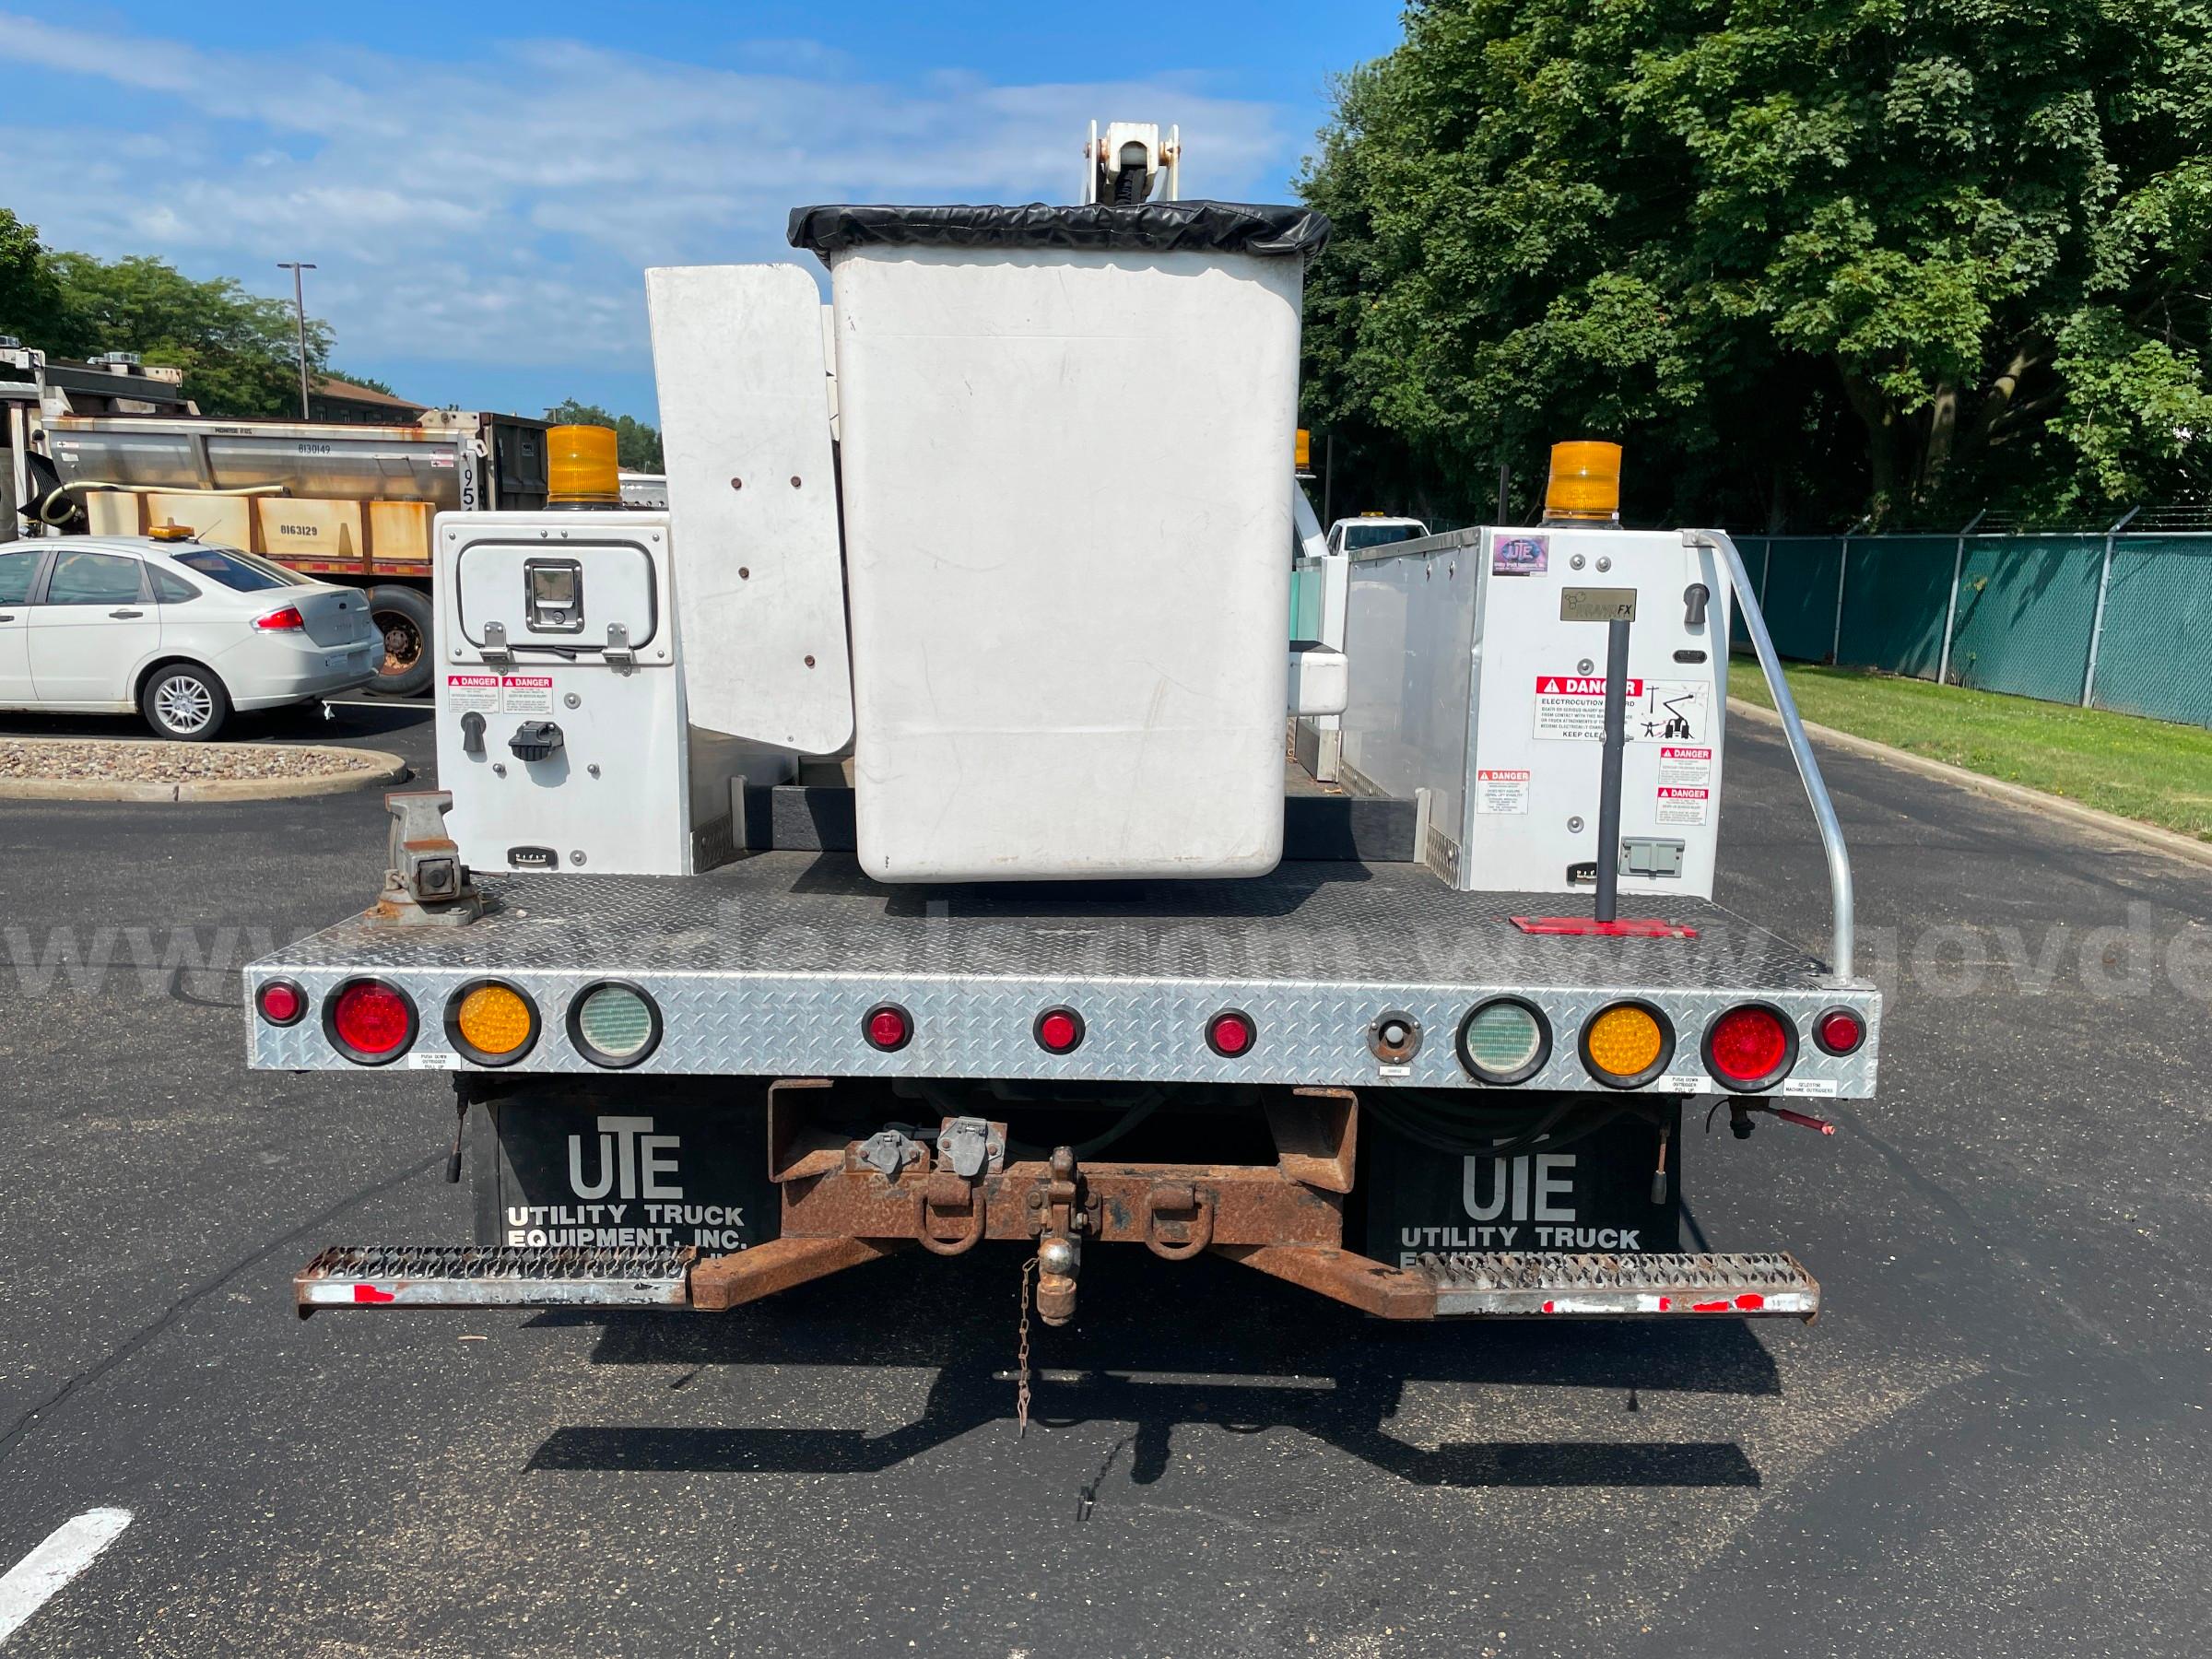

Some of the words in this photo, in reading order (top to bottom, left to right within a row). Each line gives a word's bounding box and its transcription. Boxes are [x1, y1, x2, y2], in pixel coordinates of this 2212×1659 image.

[299, 443, 331, 454] 8130149
[463, 469, 475, 512] 95
[280, 524, 318, 536] 8163129
[1508, 542, 1534, 560] UTE
[461, 677, 497, 687] DANGER
[515, 678, 550, 687] DANGER
[1566, 679, 1636, 695] DANR
[1541, 698, 1604, 707] ELECTROCUTION
[1674, 749, 1710, 759] DANGER
[1491, 771, 1529, 780] DANGER
[1670, 789, 1706, 798] DANGER
[568, 1115, 684, 1200] UTE
[508, 1205, 627, 1227] UTILITY
[644, 1205, 746, 1227] TRUCK
[694, 1229, 747, 1250] INC.
[1401, 1227, 1518, 1247] UTILITY
[1535, 1227, 1641, 1251] TRUCK
